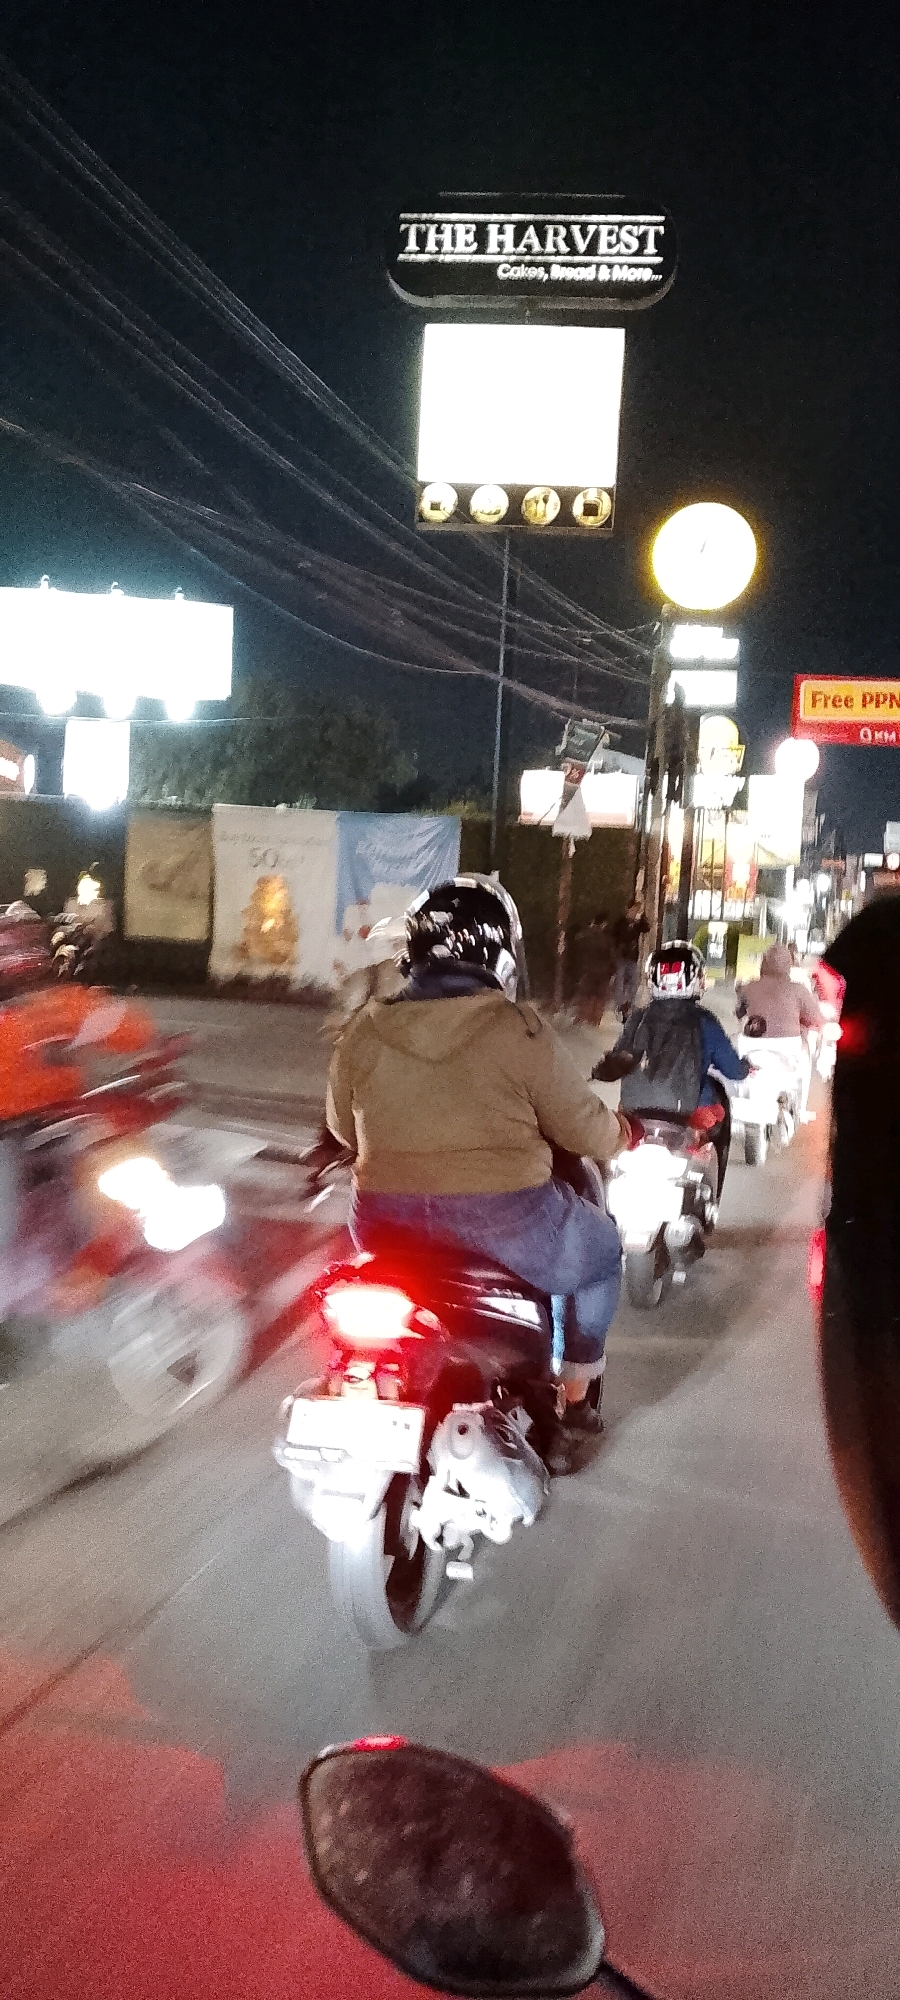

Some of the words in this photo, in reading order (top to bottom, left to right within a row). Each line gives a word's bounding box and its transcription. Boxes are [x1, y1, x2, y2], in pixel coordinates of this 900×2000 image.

[399, 223, 478, 254] THE
[485, 223, 665, 255] HARVEST
[496, 263, 549, 282] Cakes,
[550, 264, 597, 281] Bread
[598, 264, 611, 281] &
[811, 690, 854, 709] Free
